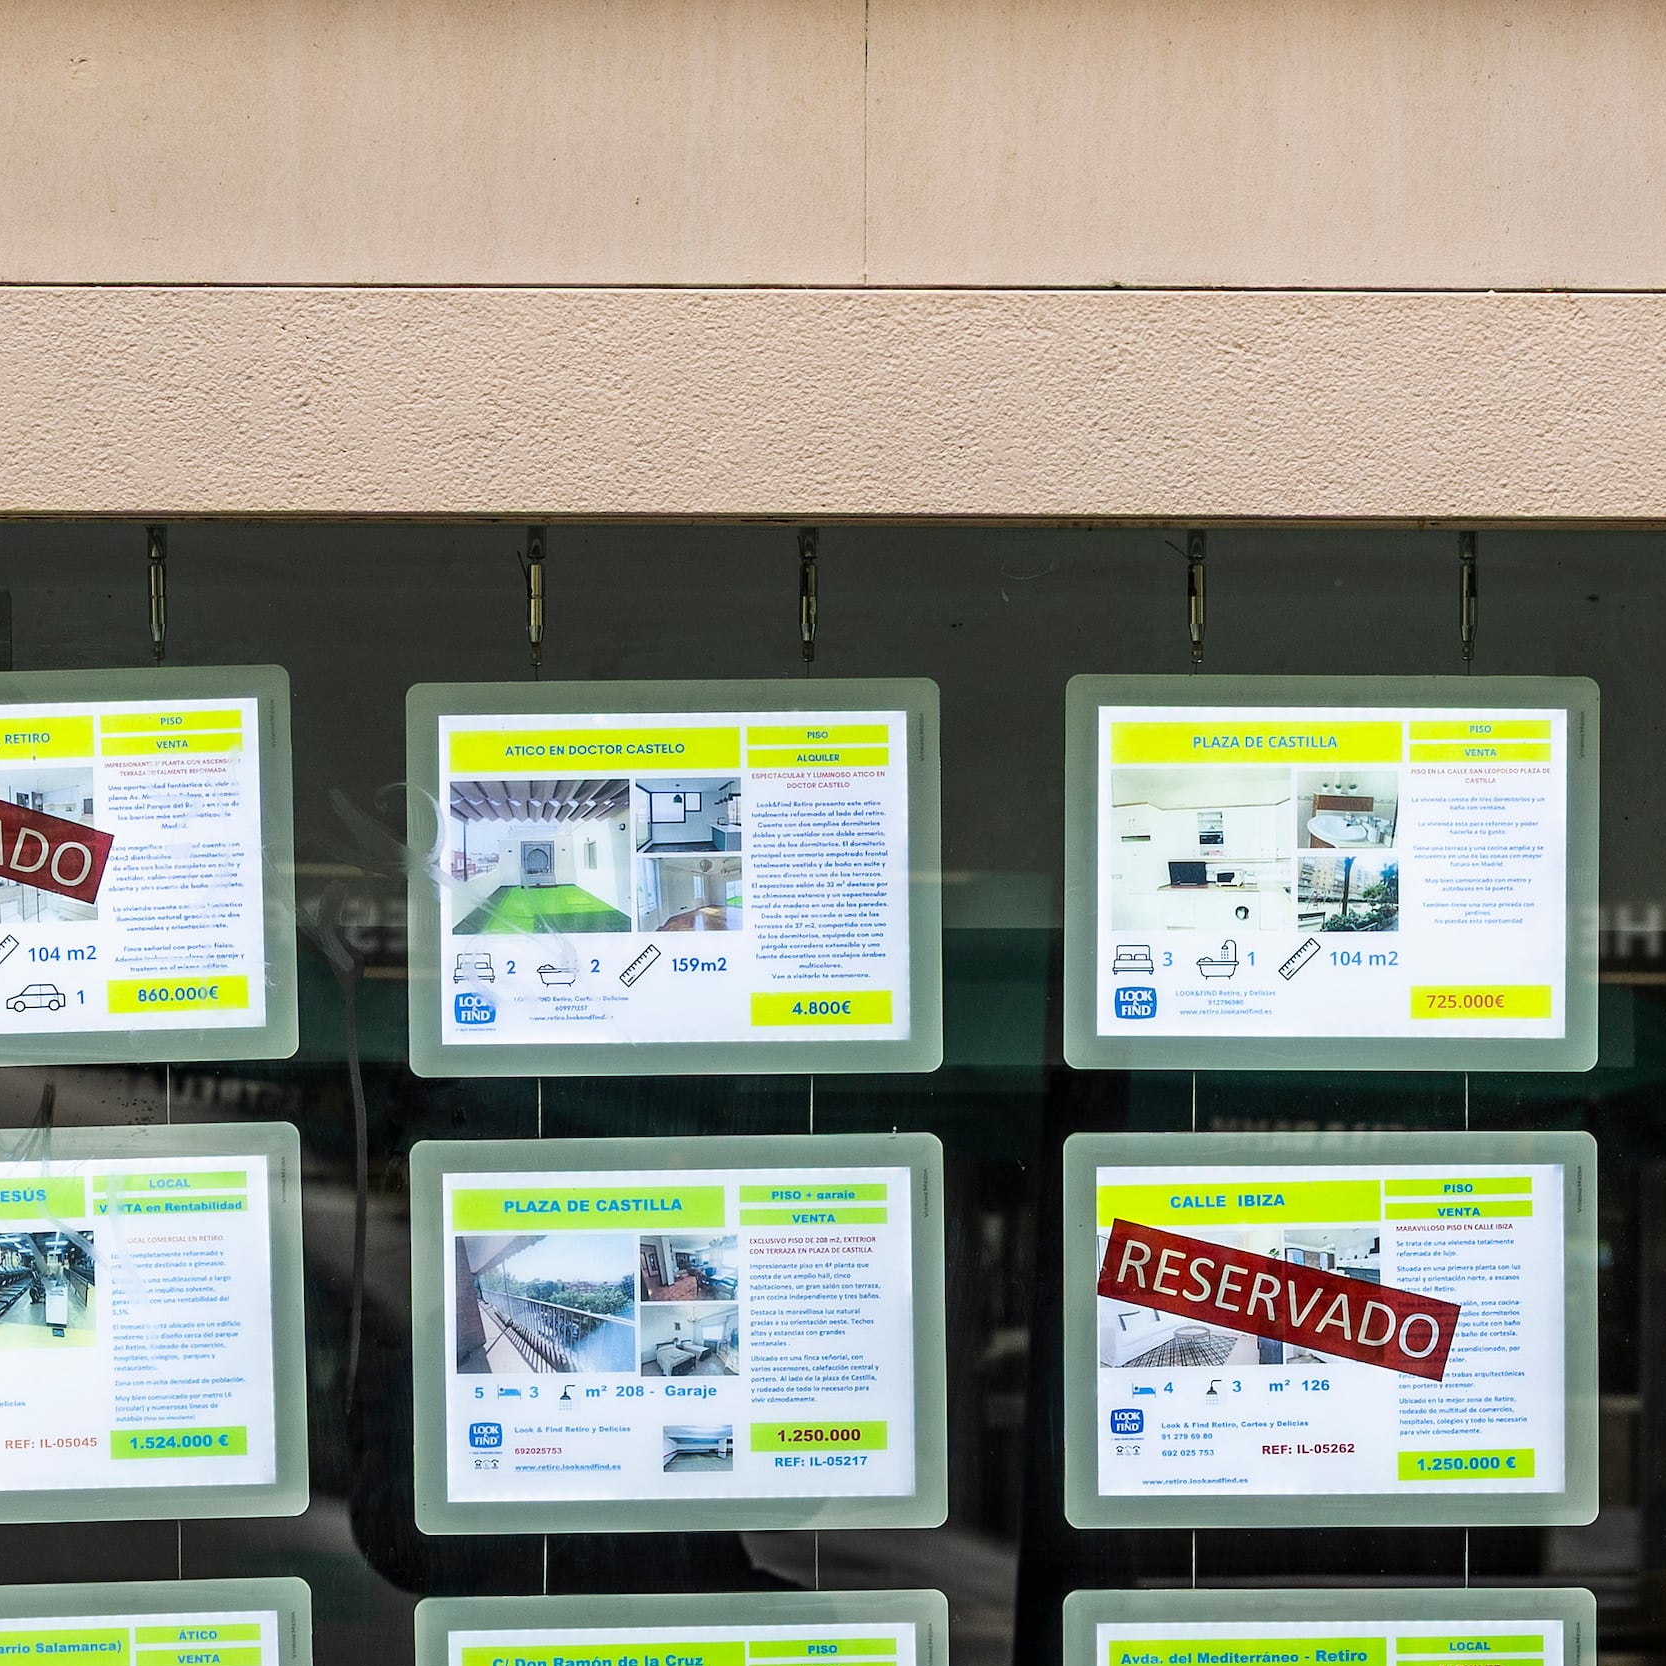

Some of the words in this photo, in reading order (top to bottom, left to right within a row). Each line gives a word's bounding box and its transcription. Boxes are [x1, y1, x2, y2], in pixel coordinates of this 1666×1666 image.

[160, 716, 183, 726] PISO
[4, 732, 51, 745] RETIRO
[806, 730, 829, 740] PISO
[156, 739, 189, 749] VENTA
[1192, 735, 1240, 749] PLAZA
[1244, 735, 1264, 749] DE
[1267, 735, 1338, 749] CASTILLA
[505, 744, 546, 757] ATICO
[549, 744, 565, 757] EN
[568, 744, 623, 756] DOCTOR
[625, 743, 686, 755] CASTELO
[1464, 748, 1497, 758] VENTA
[796, 753, 840, 763] ALQUILER
[671, 957, 728, 973] 159m2
[137, 985, 219, 1003] 860.000€
[791, 1000, 852, 1016] 4.800€
[1426, 994, 1505, 1009] 725.000€
[1443, 1183, 1474, 1194] PISO
[503, 1199, 562, 1214] PLAZA
[566, 1199, 590, 1213] DE
[595, 1198, 683, 1213] CASTILLA
[1169, 1195, 1227, 1209] CALLE
[1237, 1193, 1286, 1207] IBIZA
[791, 1213, 836, 1224] VENTA
[1436, 1207, 1481, 1217] VENTA
[749, 1237, 787, 1245] EXCLUSIVO
[787, 1237, 804, 1245] PISO
[804, 1236, 815, 1244] DE
[815, 1236, 829, 1244] 208
[1117, 1239, 1441, 1360] RESERVADO
[129, 1434, 214, 1450] 1.524.000
[217, 1433, 229, 1447] €
[777, 1428, 861, 1442] 1.250.000
[4, 1439, 35, 1450] REF:
[39, 1437, 98, 1449] IL-05045
[1261, 1444, 1293, 1455] REF:
[1296, 1443, 1356, 1455] IL-05262
[774, 1456, 805, 1468] REF:
[809, 1455, 868, 1467] IL-05217
[1417, 1456, 1501, 1471] 1.250.000
[1505, 1455, 1517, 1469] €
[178, 1629, 218, 1641] ÁTICO
[34, 1639, 123, 1654] Salamanca)
[807, 1644, 838, 1655] PISO
[1449, 1641, 1492, 1652] LOCAL
[176, 1653, 221, 1665] VENTA
[1120, 1653, 1164, 1665] Avda.
[1168, 1652, 1192, 1665] del
[1196, 1651, 1300, 1664] Mediterráneo
[1315, 1649, 1368, 1663] Retiro
